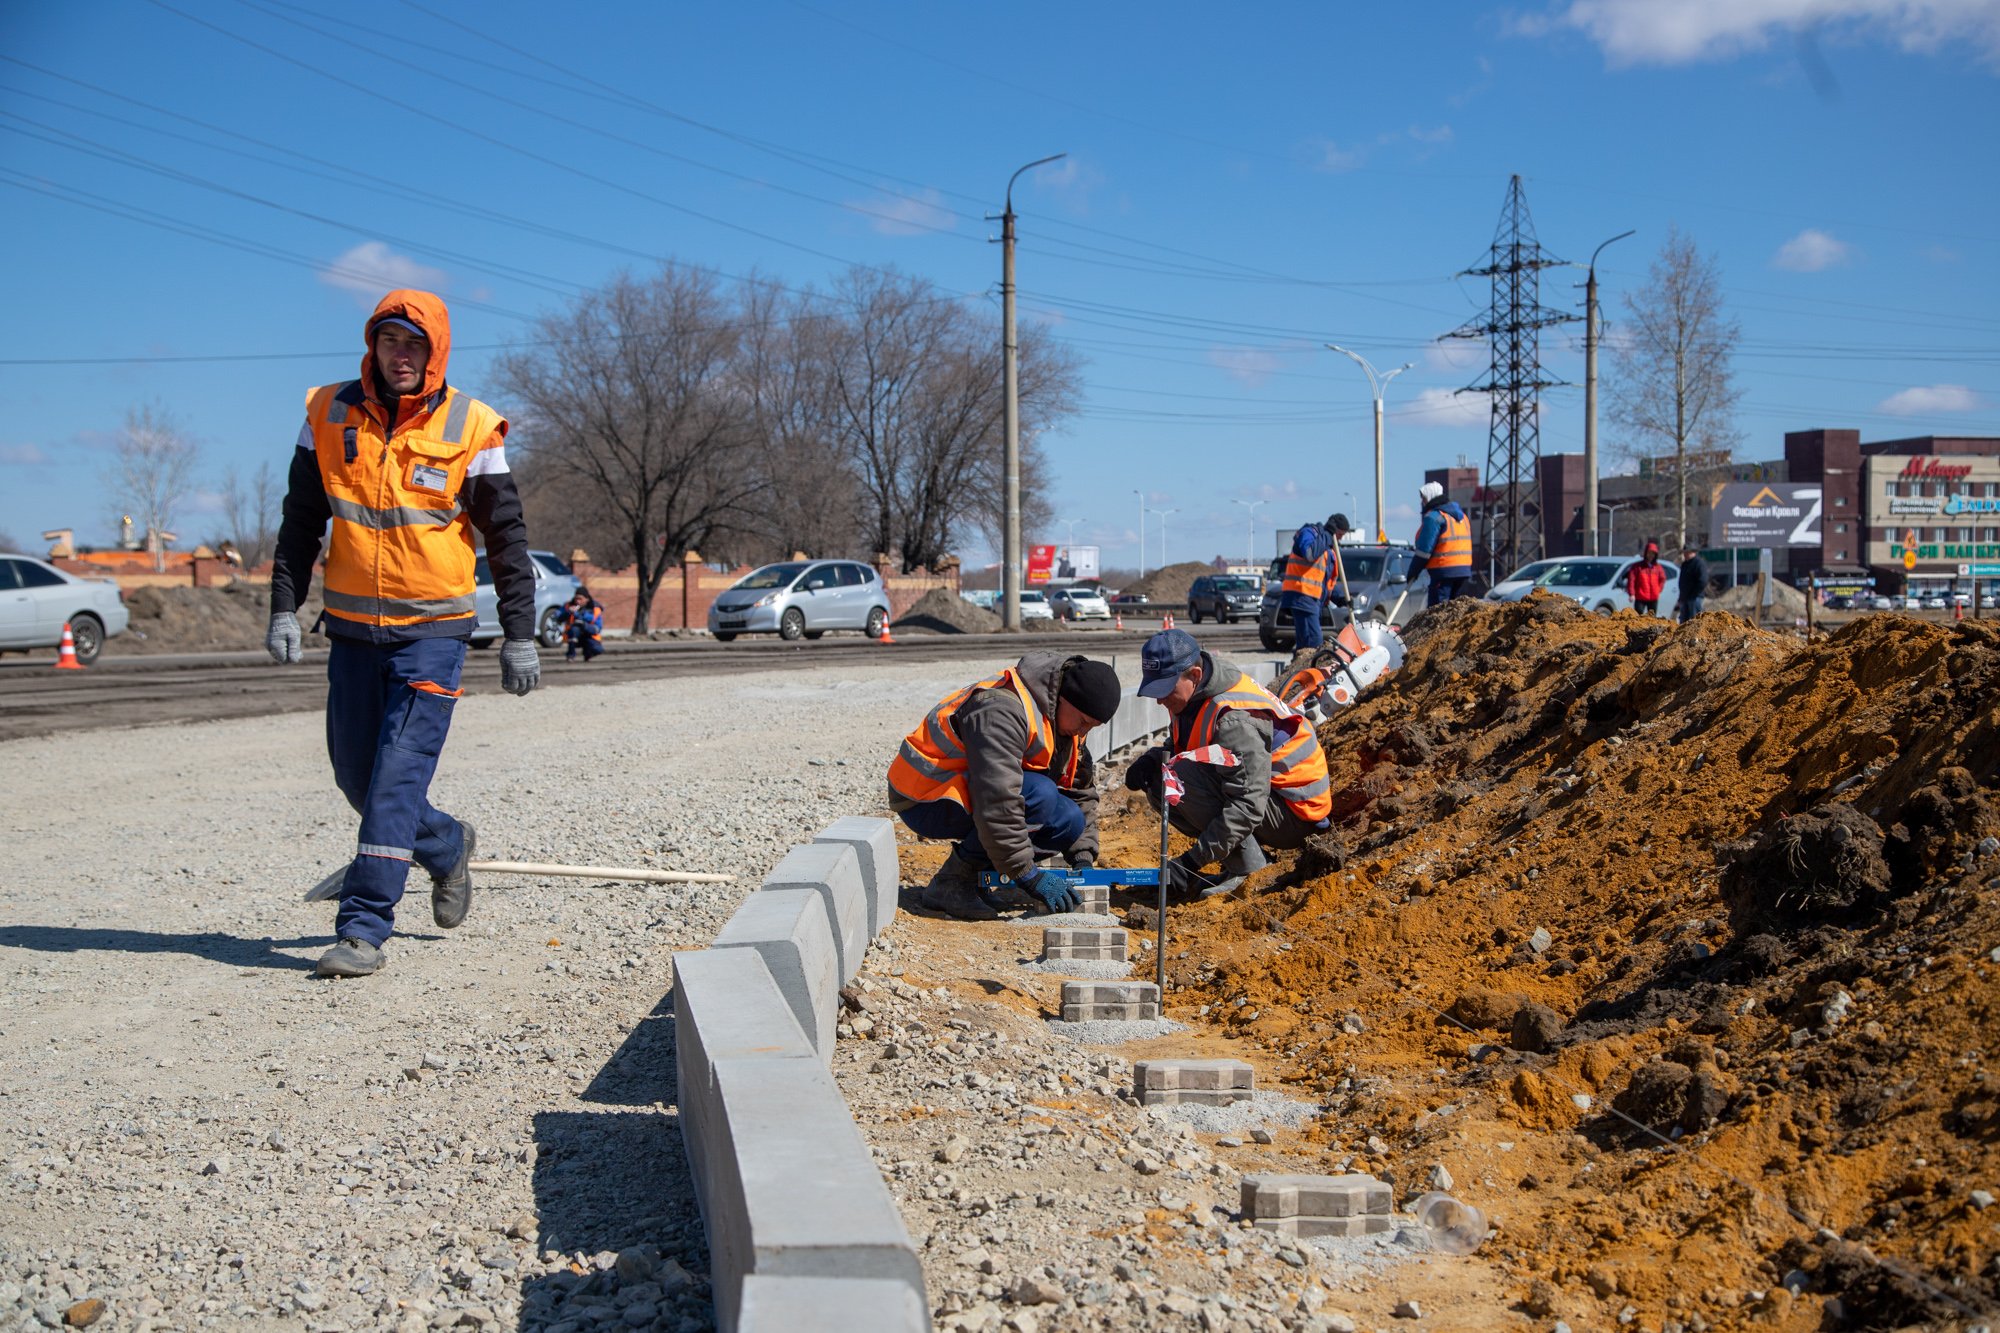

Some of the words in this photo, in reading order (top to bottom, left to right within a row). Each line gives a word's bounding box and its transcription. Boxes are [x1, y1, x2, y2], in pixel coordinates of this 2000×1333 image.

[1732, 505, 1764, 518] Фасады
[1765, 507, 1771, 517] и
[1771, 505, 1800, 519] Кровля
